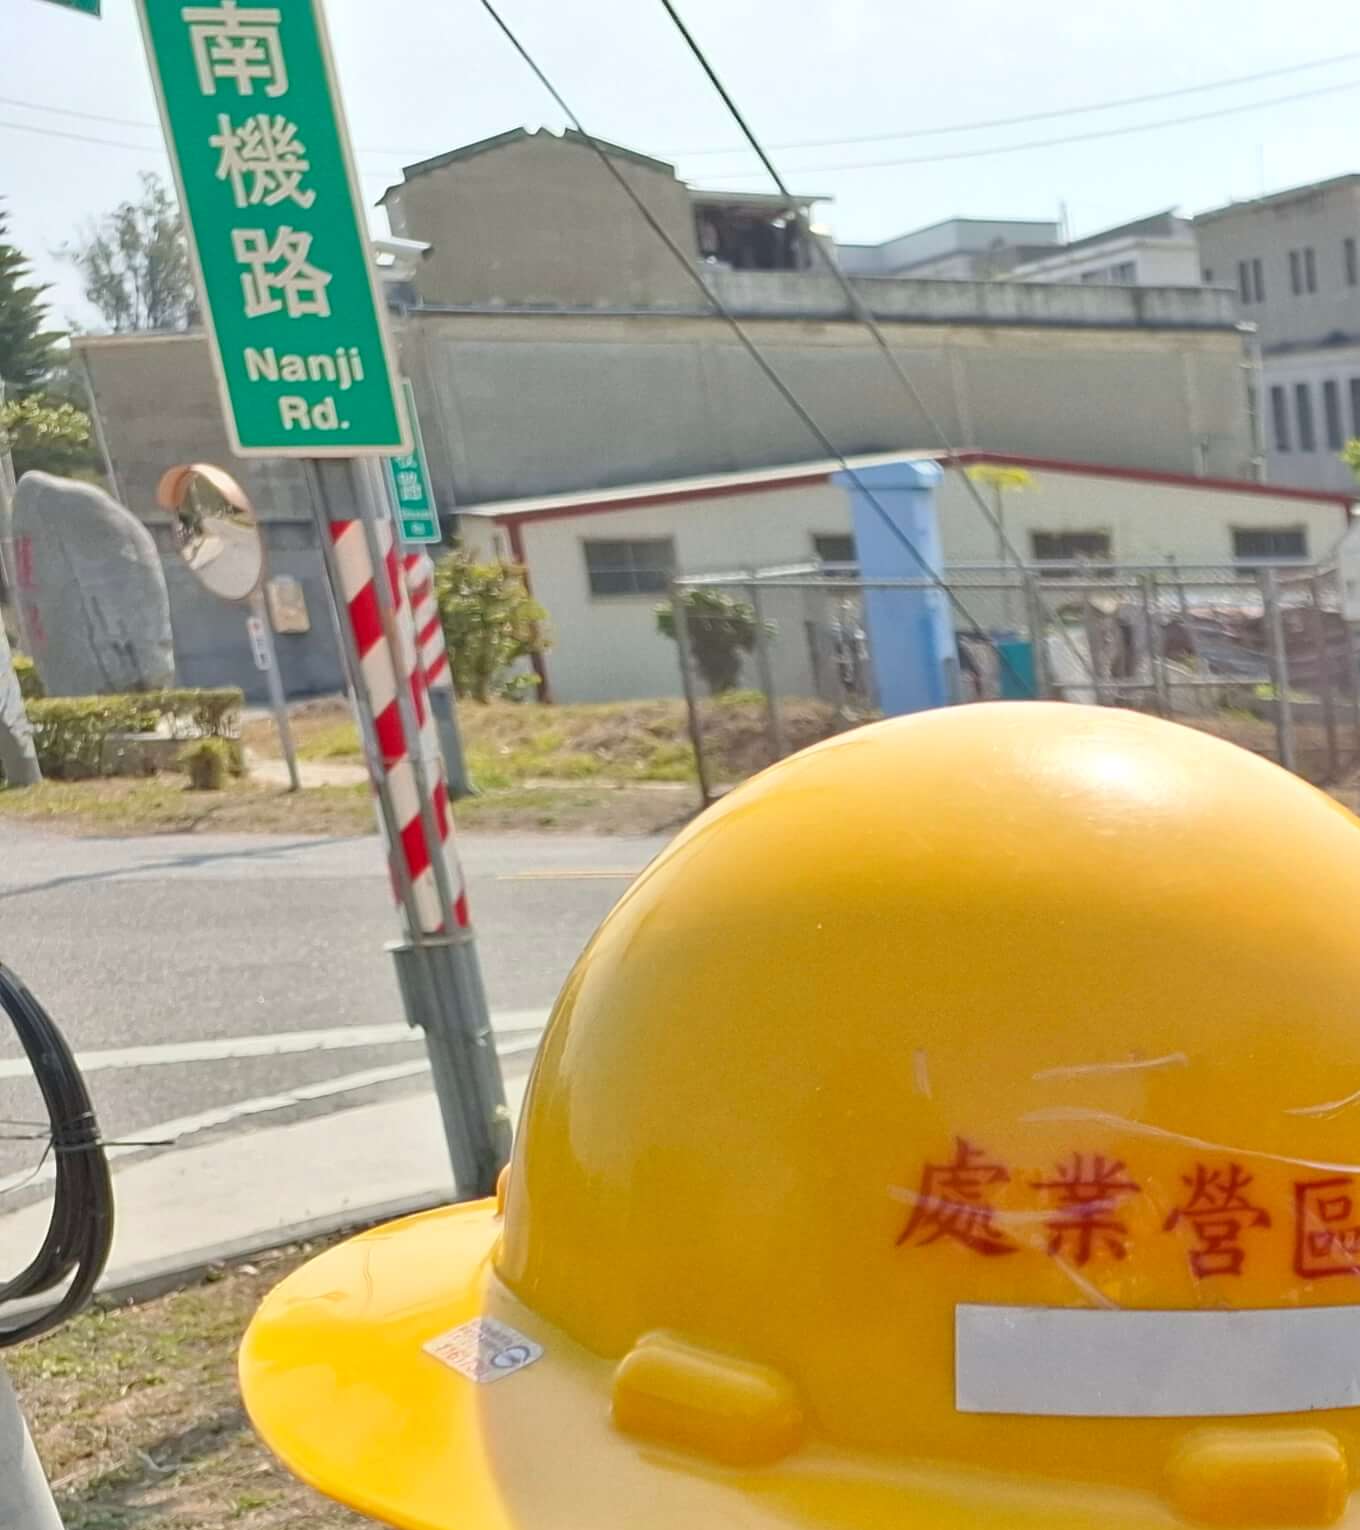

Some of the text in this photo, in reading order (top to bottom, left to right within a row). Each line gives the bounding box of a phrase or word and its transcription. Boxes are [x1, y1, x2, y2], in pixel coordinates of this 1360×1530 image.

[181, 0, 332, 320] 南機路
[245, 347, 364, 390] Nanji
[278, 396, 350, 430] Rd.
